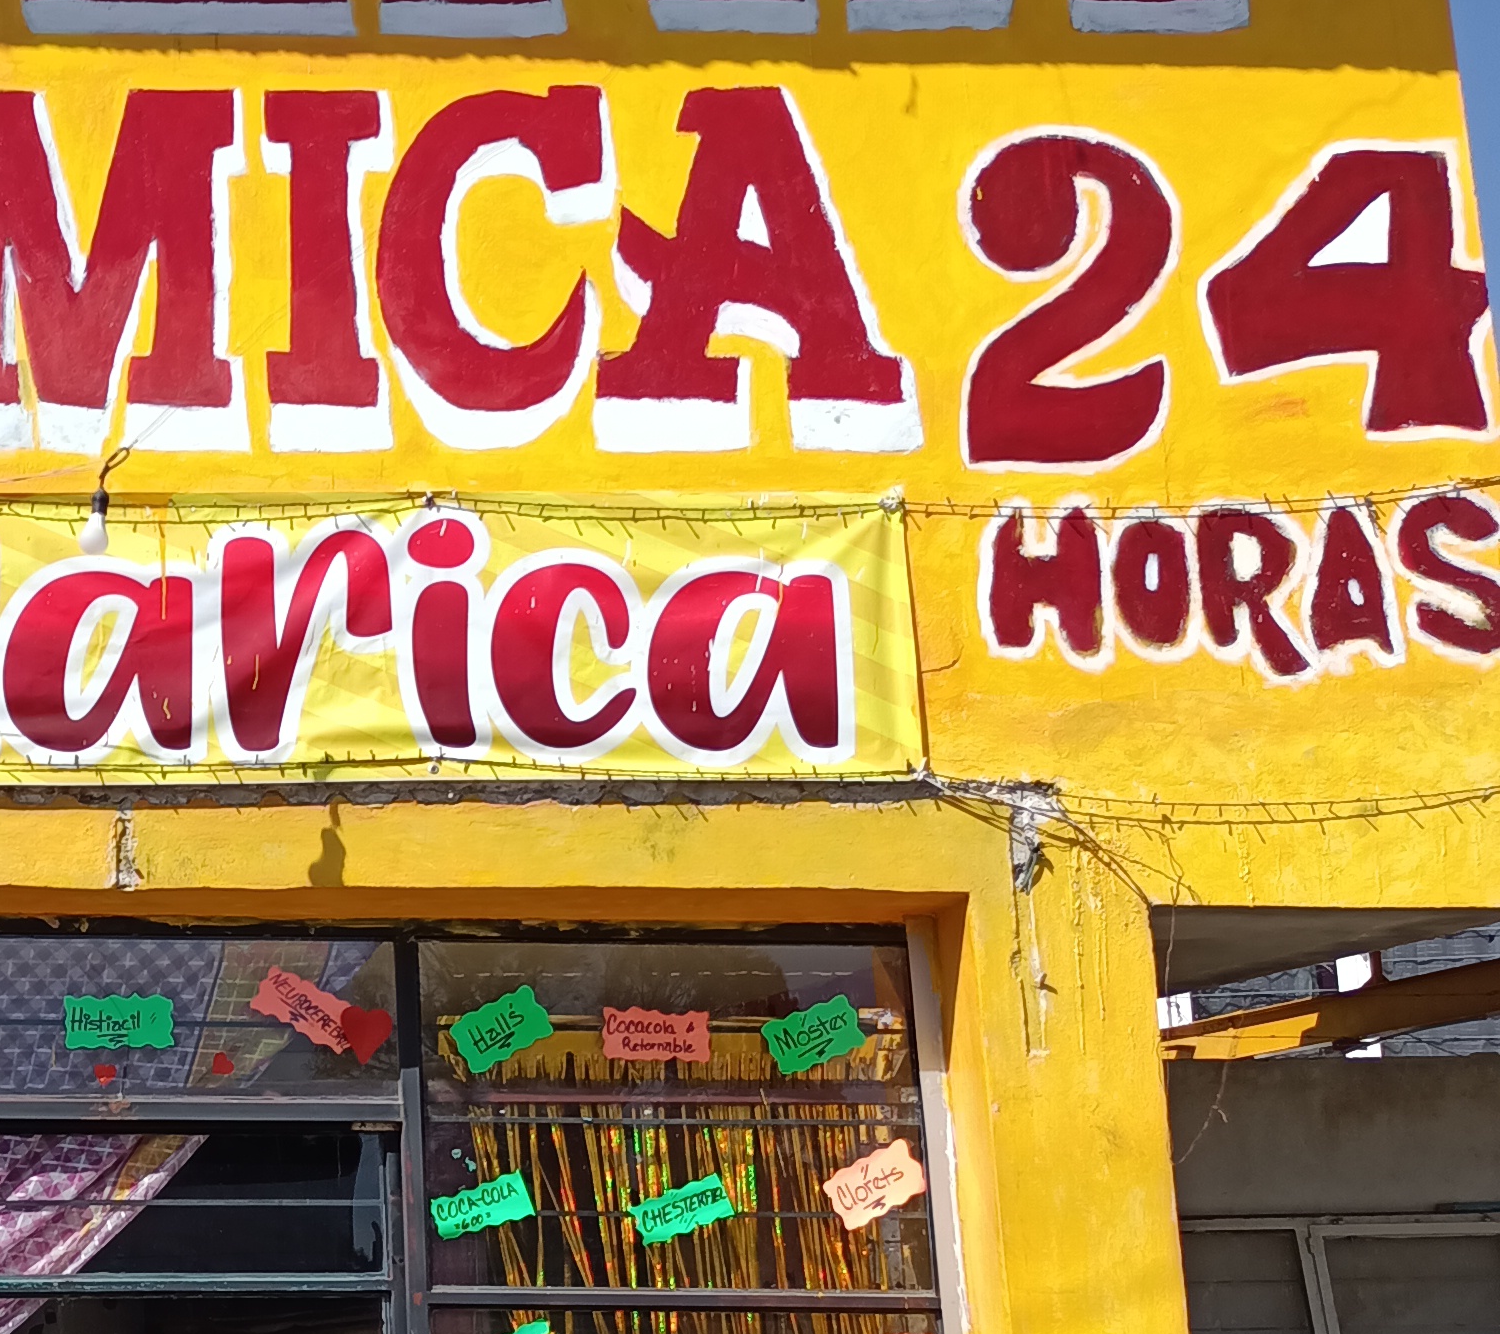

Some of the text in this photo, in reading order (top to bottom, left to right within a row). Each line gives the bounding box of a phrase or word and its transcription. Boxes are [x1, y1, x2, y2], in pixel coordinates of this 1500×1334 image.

[959, 125, 1499, 473] 24
[980, 480, 1500, 686] HORAS
[437, 1182, 519, 1221] COCA-COLA
[836, 1167, 904, 1210] Clorets
